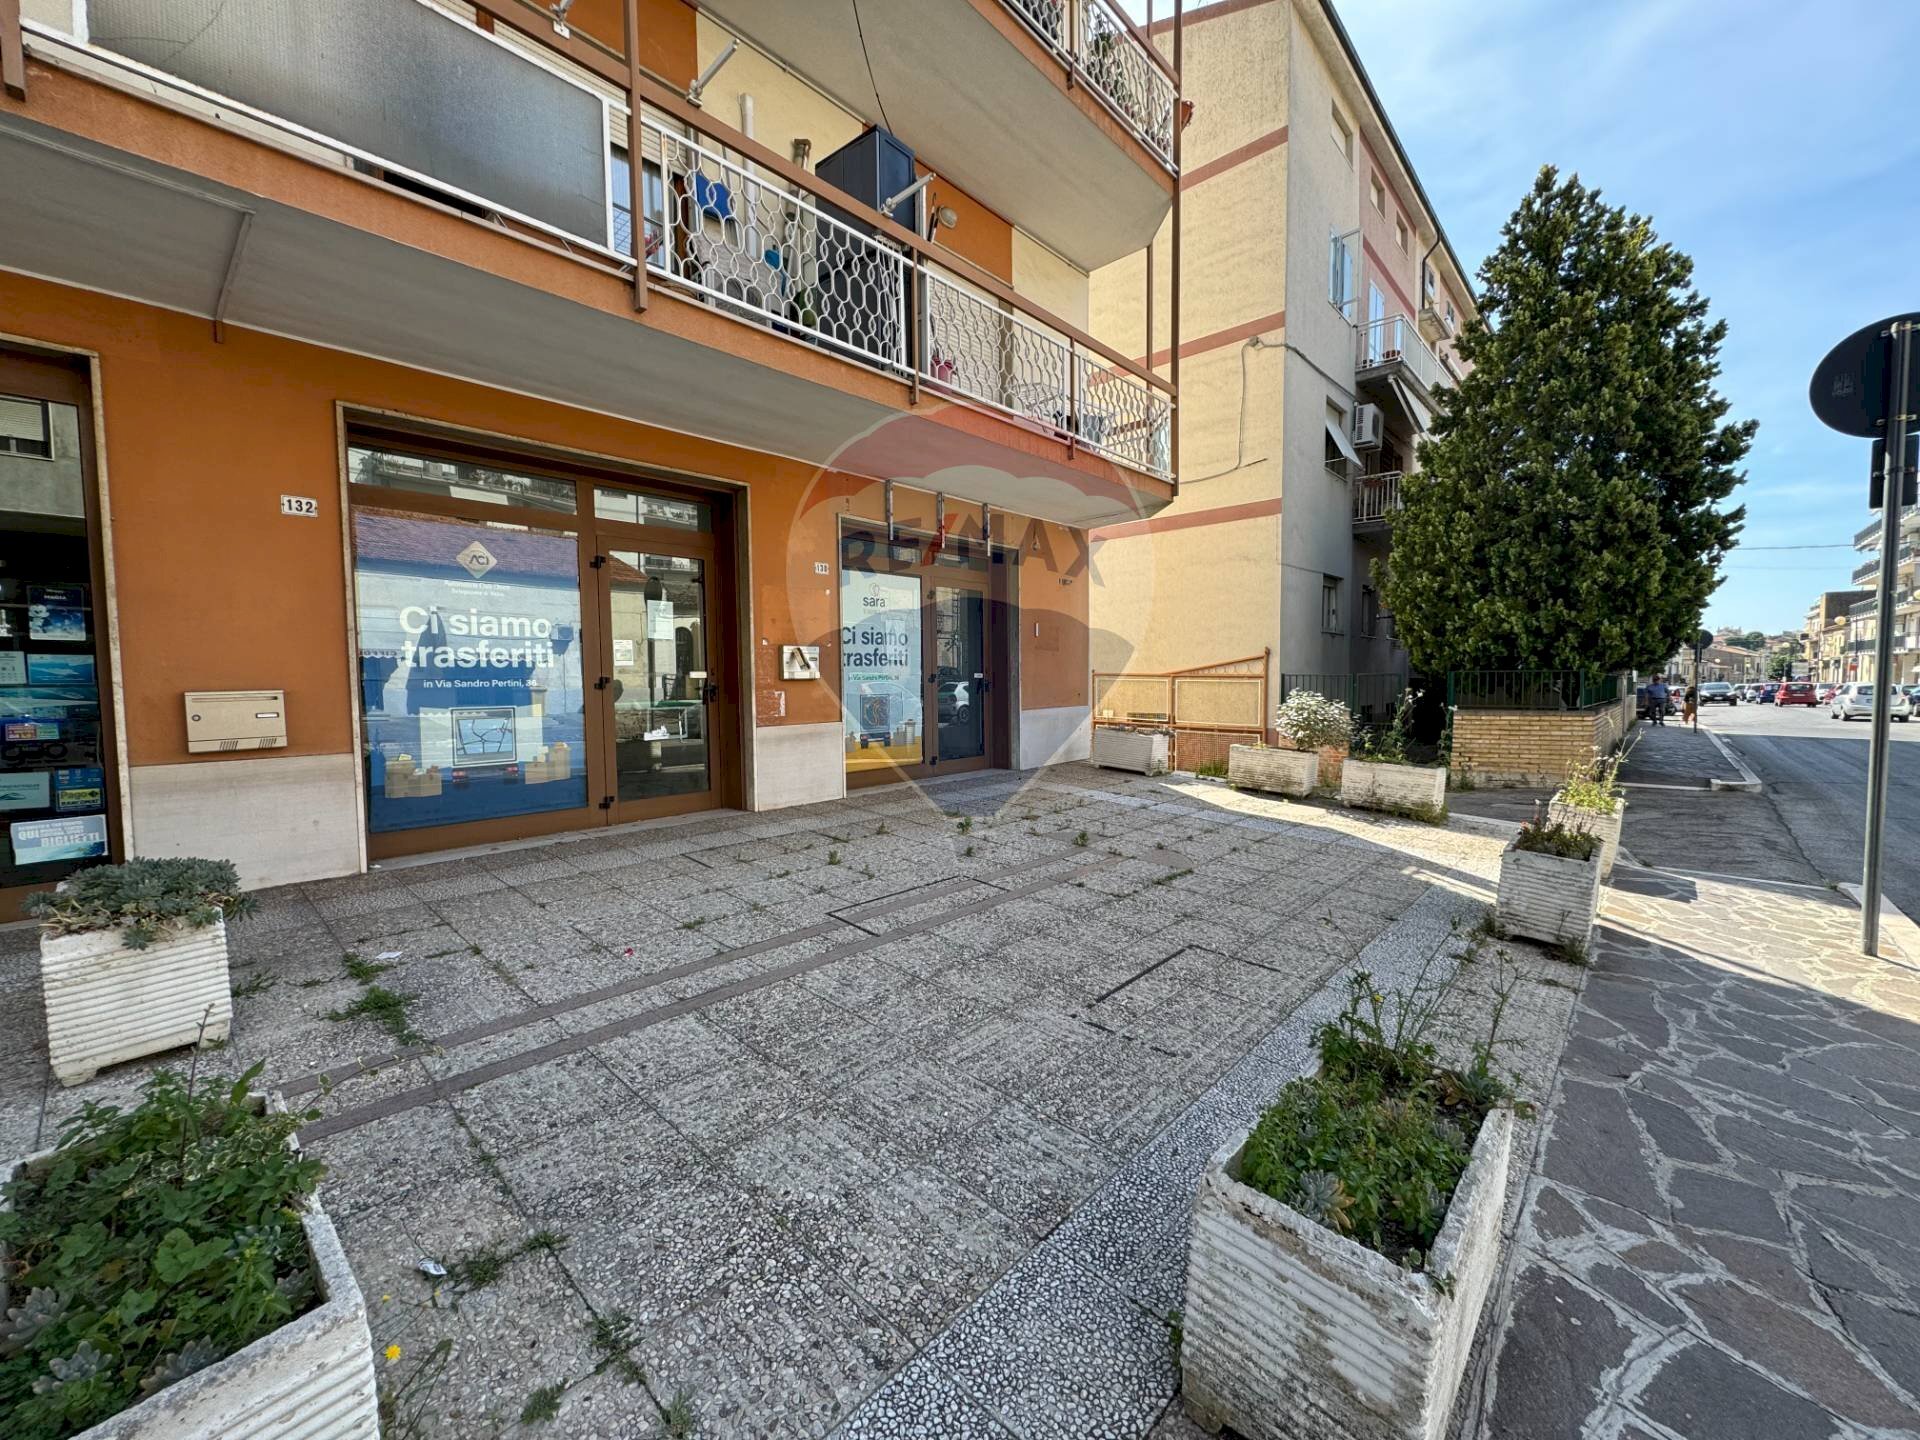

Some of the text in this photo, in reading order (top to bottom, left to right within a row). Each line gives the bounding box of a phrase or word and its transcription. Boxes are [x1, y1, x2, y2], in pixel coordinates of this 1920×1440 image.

[286, 499, 314, 514] 132
[468, 554, 490, 566] ACI
[863, 596, 886, 608] sara
[400, 606, 552, 639] Ci siamo
[841, 626, 909, 646] Ci siamo
[401, 640, 554, 669] trasferiti
[423, 680, 433, 688] in
[435, 680, 452, 688] Via
[454, 679, 490, 688] Sandro
[492, 679, 524, 689] Pertini,
